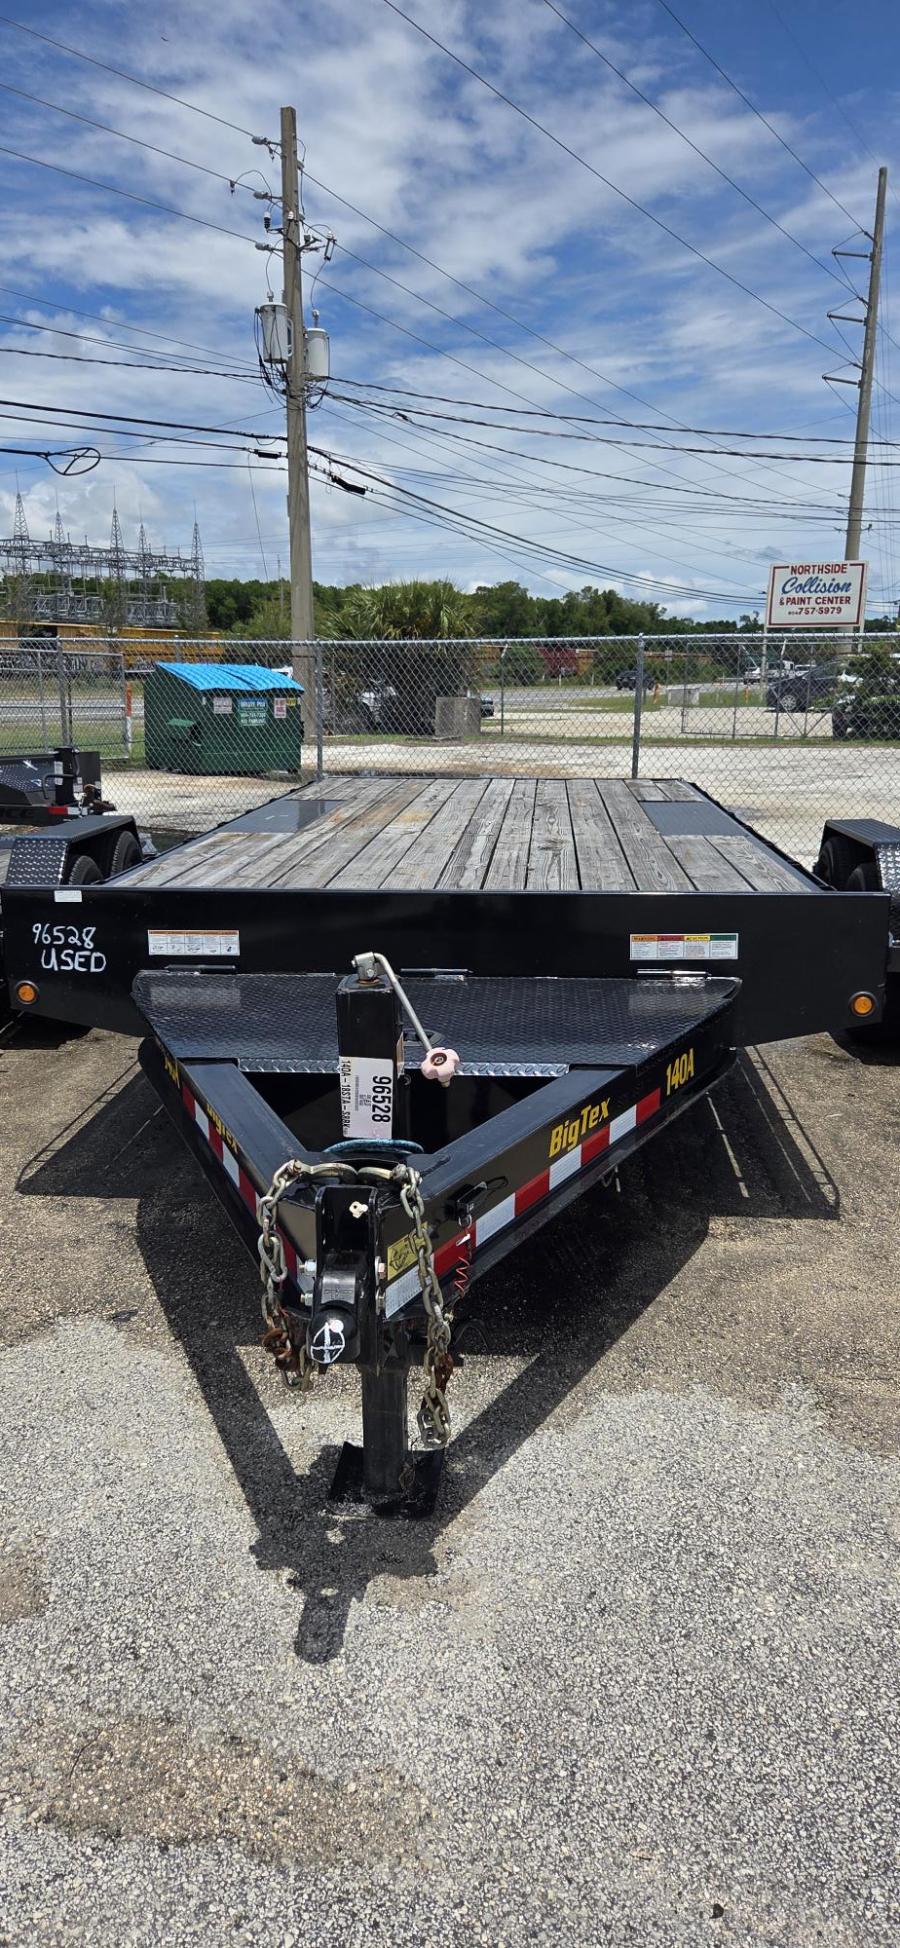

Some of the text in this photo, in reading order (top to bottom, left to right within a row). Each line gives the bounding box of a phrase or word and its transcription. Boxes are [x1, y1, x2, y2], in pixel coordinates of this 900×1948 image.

[790, 564, 847, 575] NORTHSIDE
[781, 576, 852, 594] Collision
[779, 596, 851, 606] & PAINT CENTER
[32, 923, 96, 949] 96528
[41, 948, 107, 973] USED
[371, 1075, 392, 1123] 96528
[548, 1097, 611, 1158] BigTex
